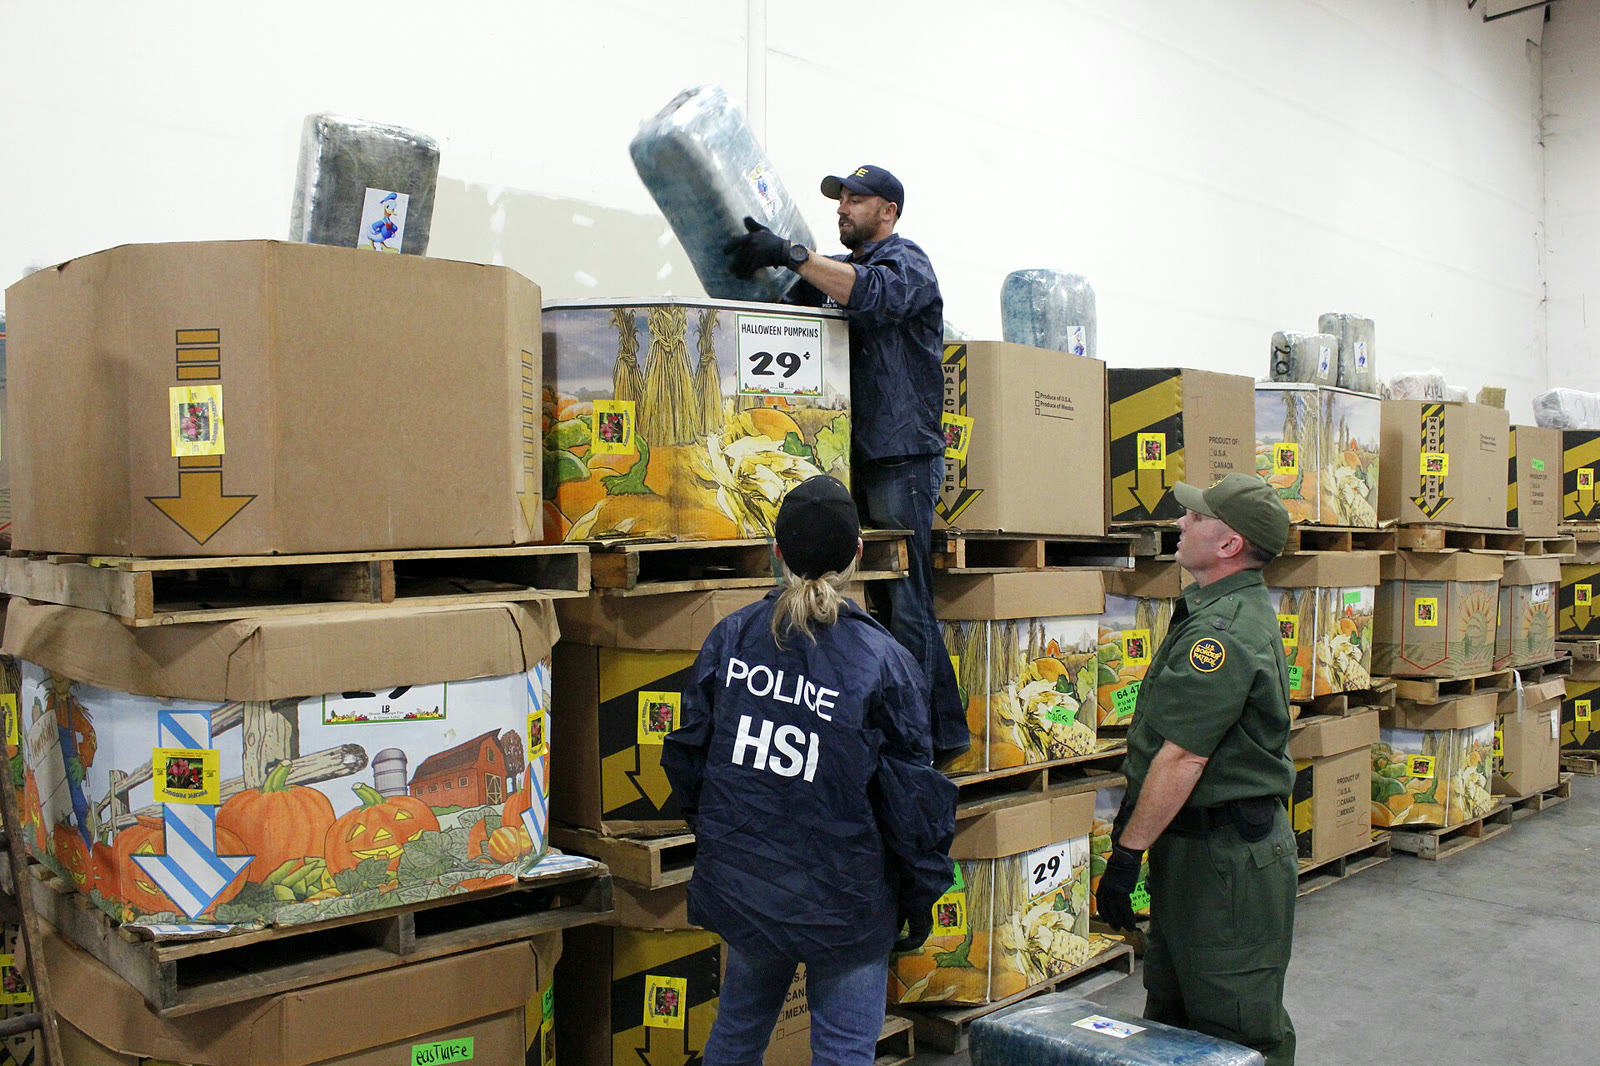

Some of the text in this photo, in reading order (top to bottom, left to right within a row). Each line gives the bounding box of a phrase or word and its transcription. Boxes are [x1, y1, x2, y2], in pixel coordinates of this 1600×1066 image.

[741, 323, 819, 338] HALLOWEEN PUMPKINS
[1040, 392, 1057, 401] Produce
[1040, 400, 1057, 409] Produce
[1208, 436, 1231, 445] PRODUCT
[1213, 461, 1233, 469] CANADA
[726, 657, 840, 722] POLICE
[1116, 689, 1128, 699] 64
[381, 704, 390, 713] LB
[732, 714, 820, 783] HSI
[1337, 774, 1355, 784] PRODUCT
[1340, 796, 1356, 806] CANADA
[1340, 806, 1355, 816] MEXICO
[785, 987, 807, 1003] CAN
[785, 1003, 809, 1020] MEXI
